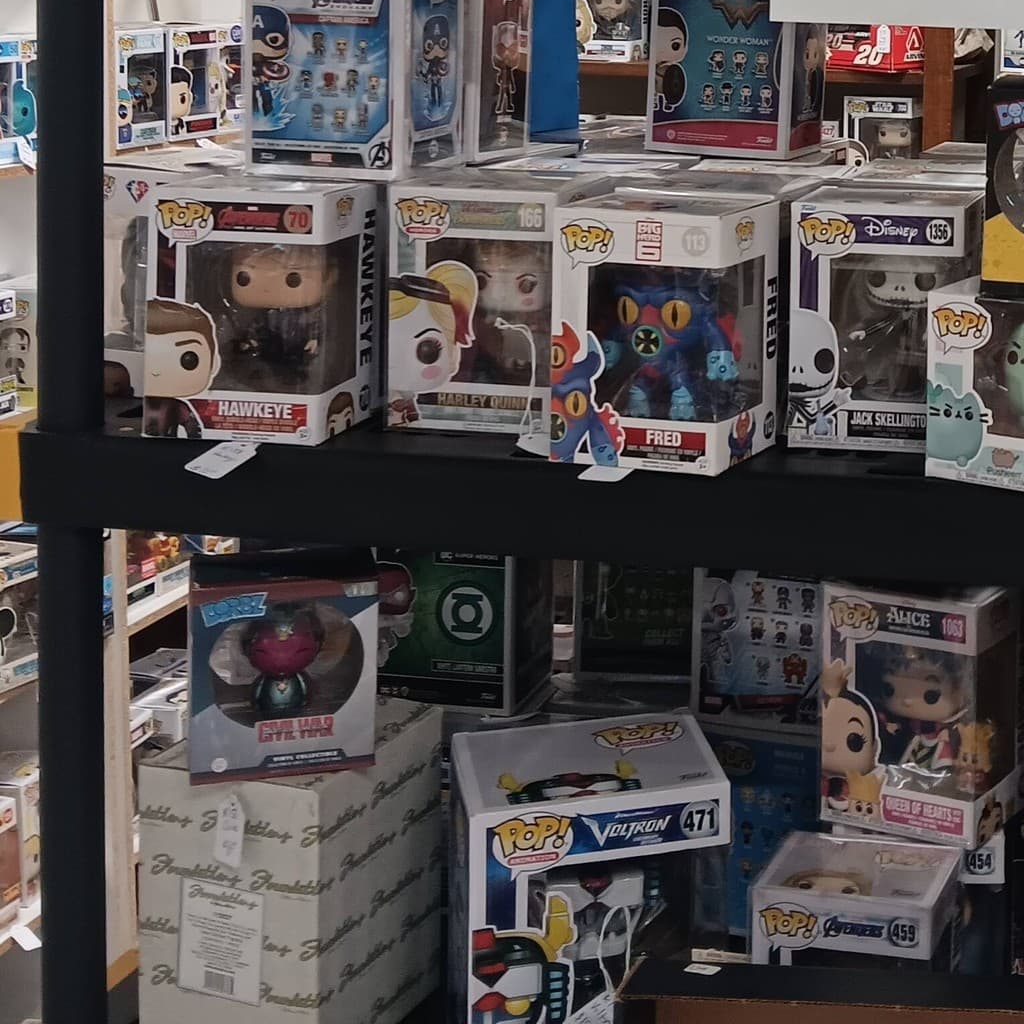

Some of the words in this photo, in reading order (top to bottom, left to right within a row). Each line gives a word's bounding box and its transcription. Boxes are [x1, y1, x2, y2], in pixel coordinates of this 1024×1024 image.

[706, 35, 737, 46] WONDER
[738, 37, 770, 46] WOMAN
[157, 199, 212, 229] POP!
[288, 212, 309, 229] 70
[396, 198, 450, 226] POP!
[517, 206, 543, 228] 166
[560, 224, 614, 254] POP!
[638, 221, 663, 236] BIG
[798, 218, 855, 246] POP!
[861, 216, 919, 243] Disney
[928, 221, 949, 242] 1356
[685, 234, 708, 252] 113
[359, 208, 377, 368] HAWKEYE
[766, 275, 778, 361] FRED
[932, 308, 988, 339] POP!
[218, 400, 293, 420] HAWKEYE
[437, 392, 487, 409] HARLEY
[850, 411, 873, 427] JACK
[645, 429, 682, 447] FRED
[828, 599, 879, 631] POP!
[886, 607, 932, 628] ALICE
[593, 721, 681, 746] POP!
[683, 807, 716, 833] 471
[923, 802, 953, 822] HEARTS
[493, 816, 572, 857] POP!
[576, 813, 673, 847] VOLTRON
[969, 853, 992, 869] 454
[758, 907, 818, 939] POP!
[890, 923, 916, 943] 459
